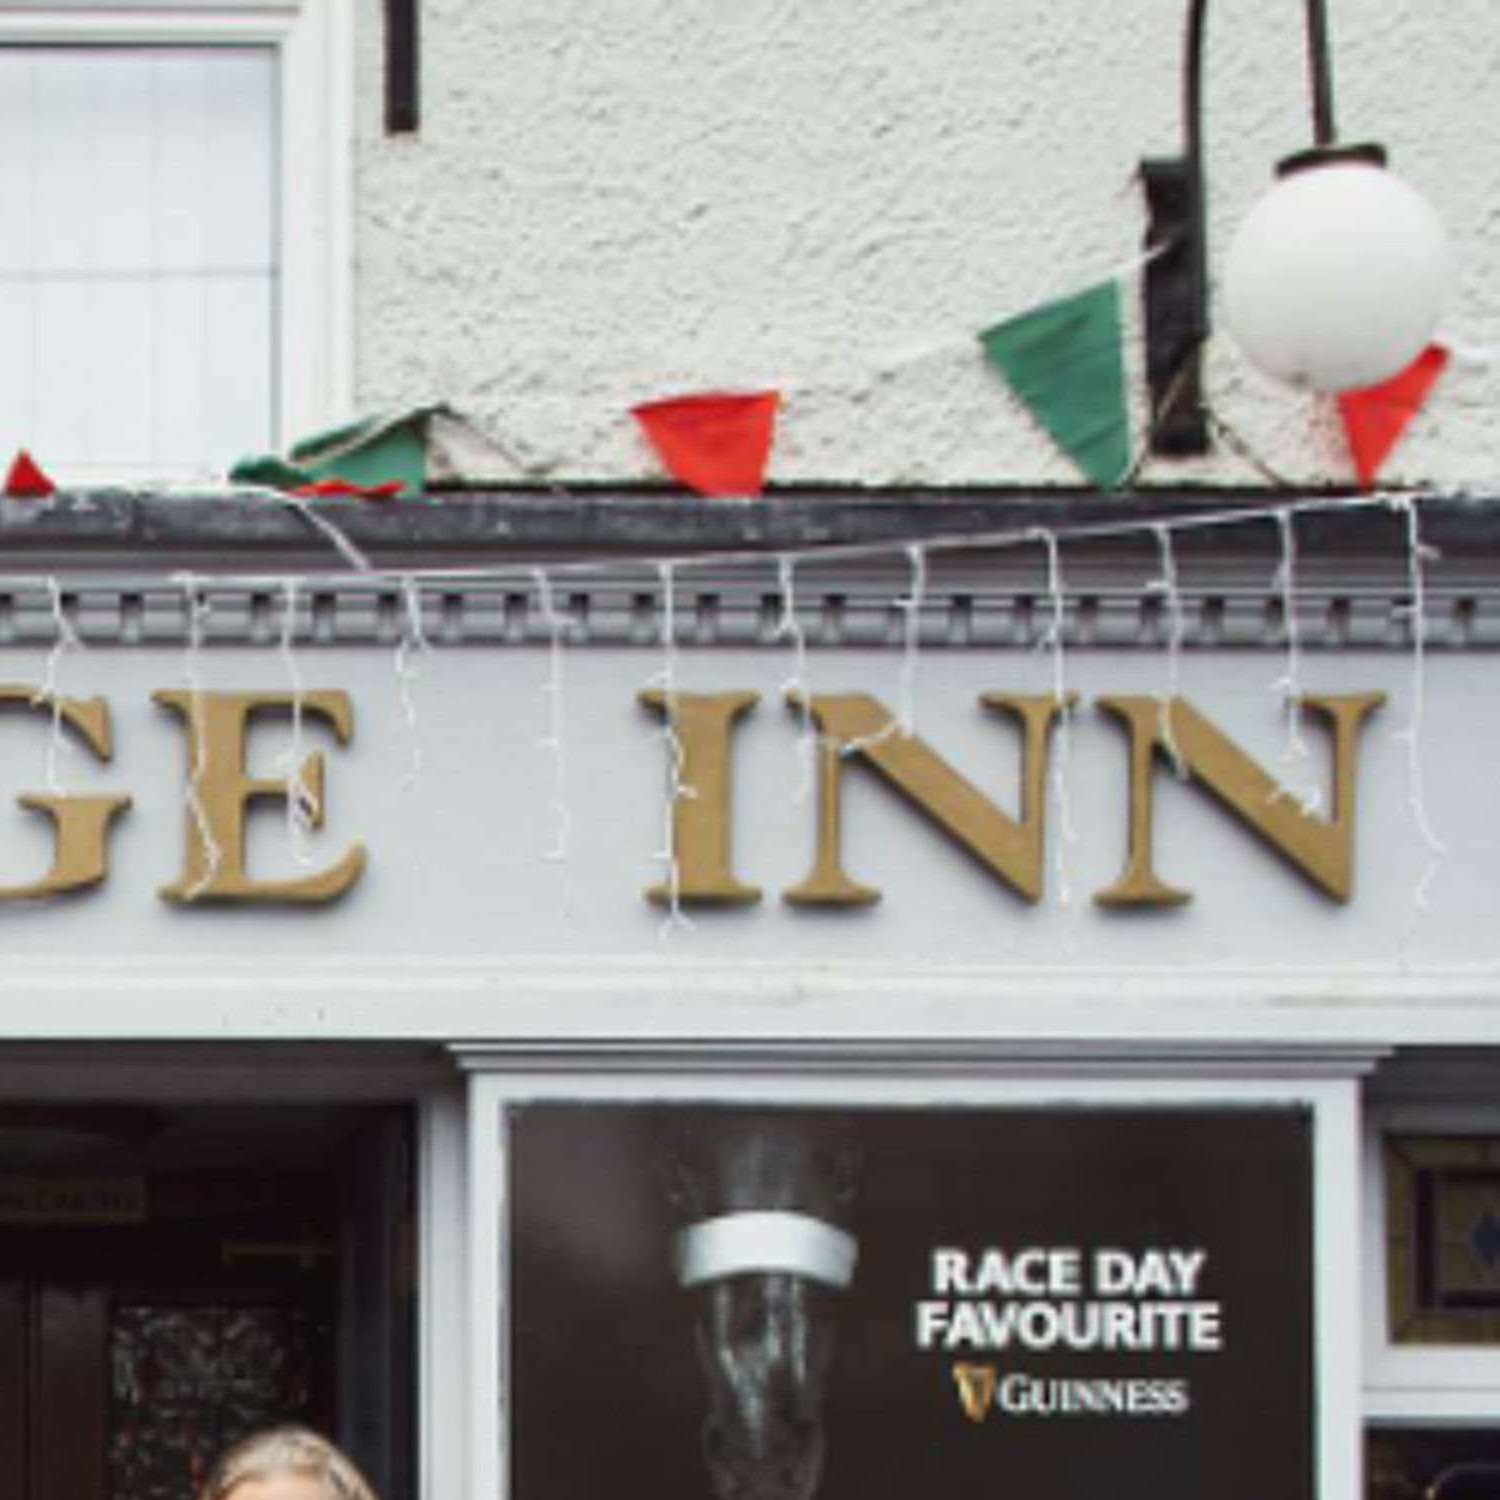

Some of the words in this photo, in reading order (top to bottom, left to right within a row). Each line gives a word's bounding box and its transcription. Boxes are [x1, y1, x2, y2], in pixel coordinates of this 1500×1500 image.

[637, 690, 1388, 907] INN
[932, 1248, 1082, 1296] RACE
[1094, 1249, 1206, 1296] DAY
[916, 1301, 1222, 1350] FAVOURITE
[999, 1373, 1189, 1414] GUINNESS
